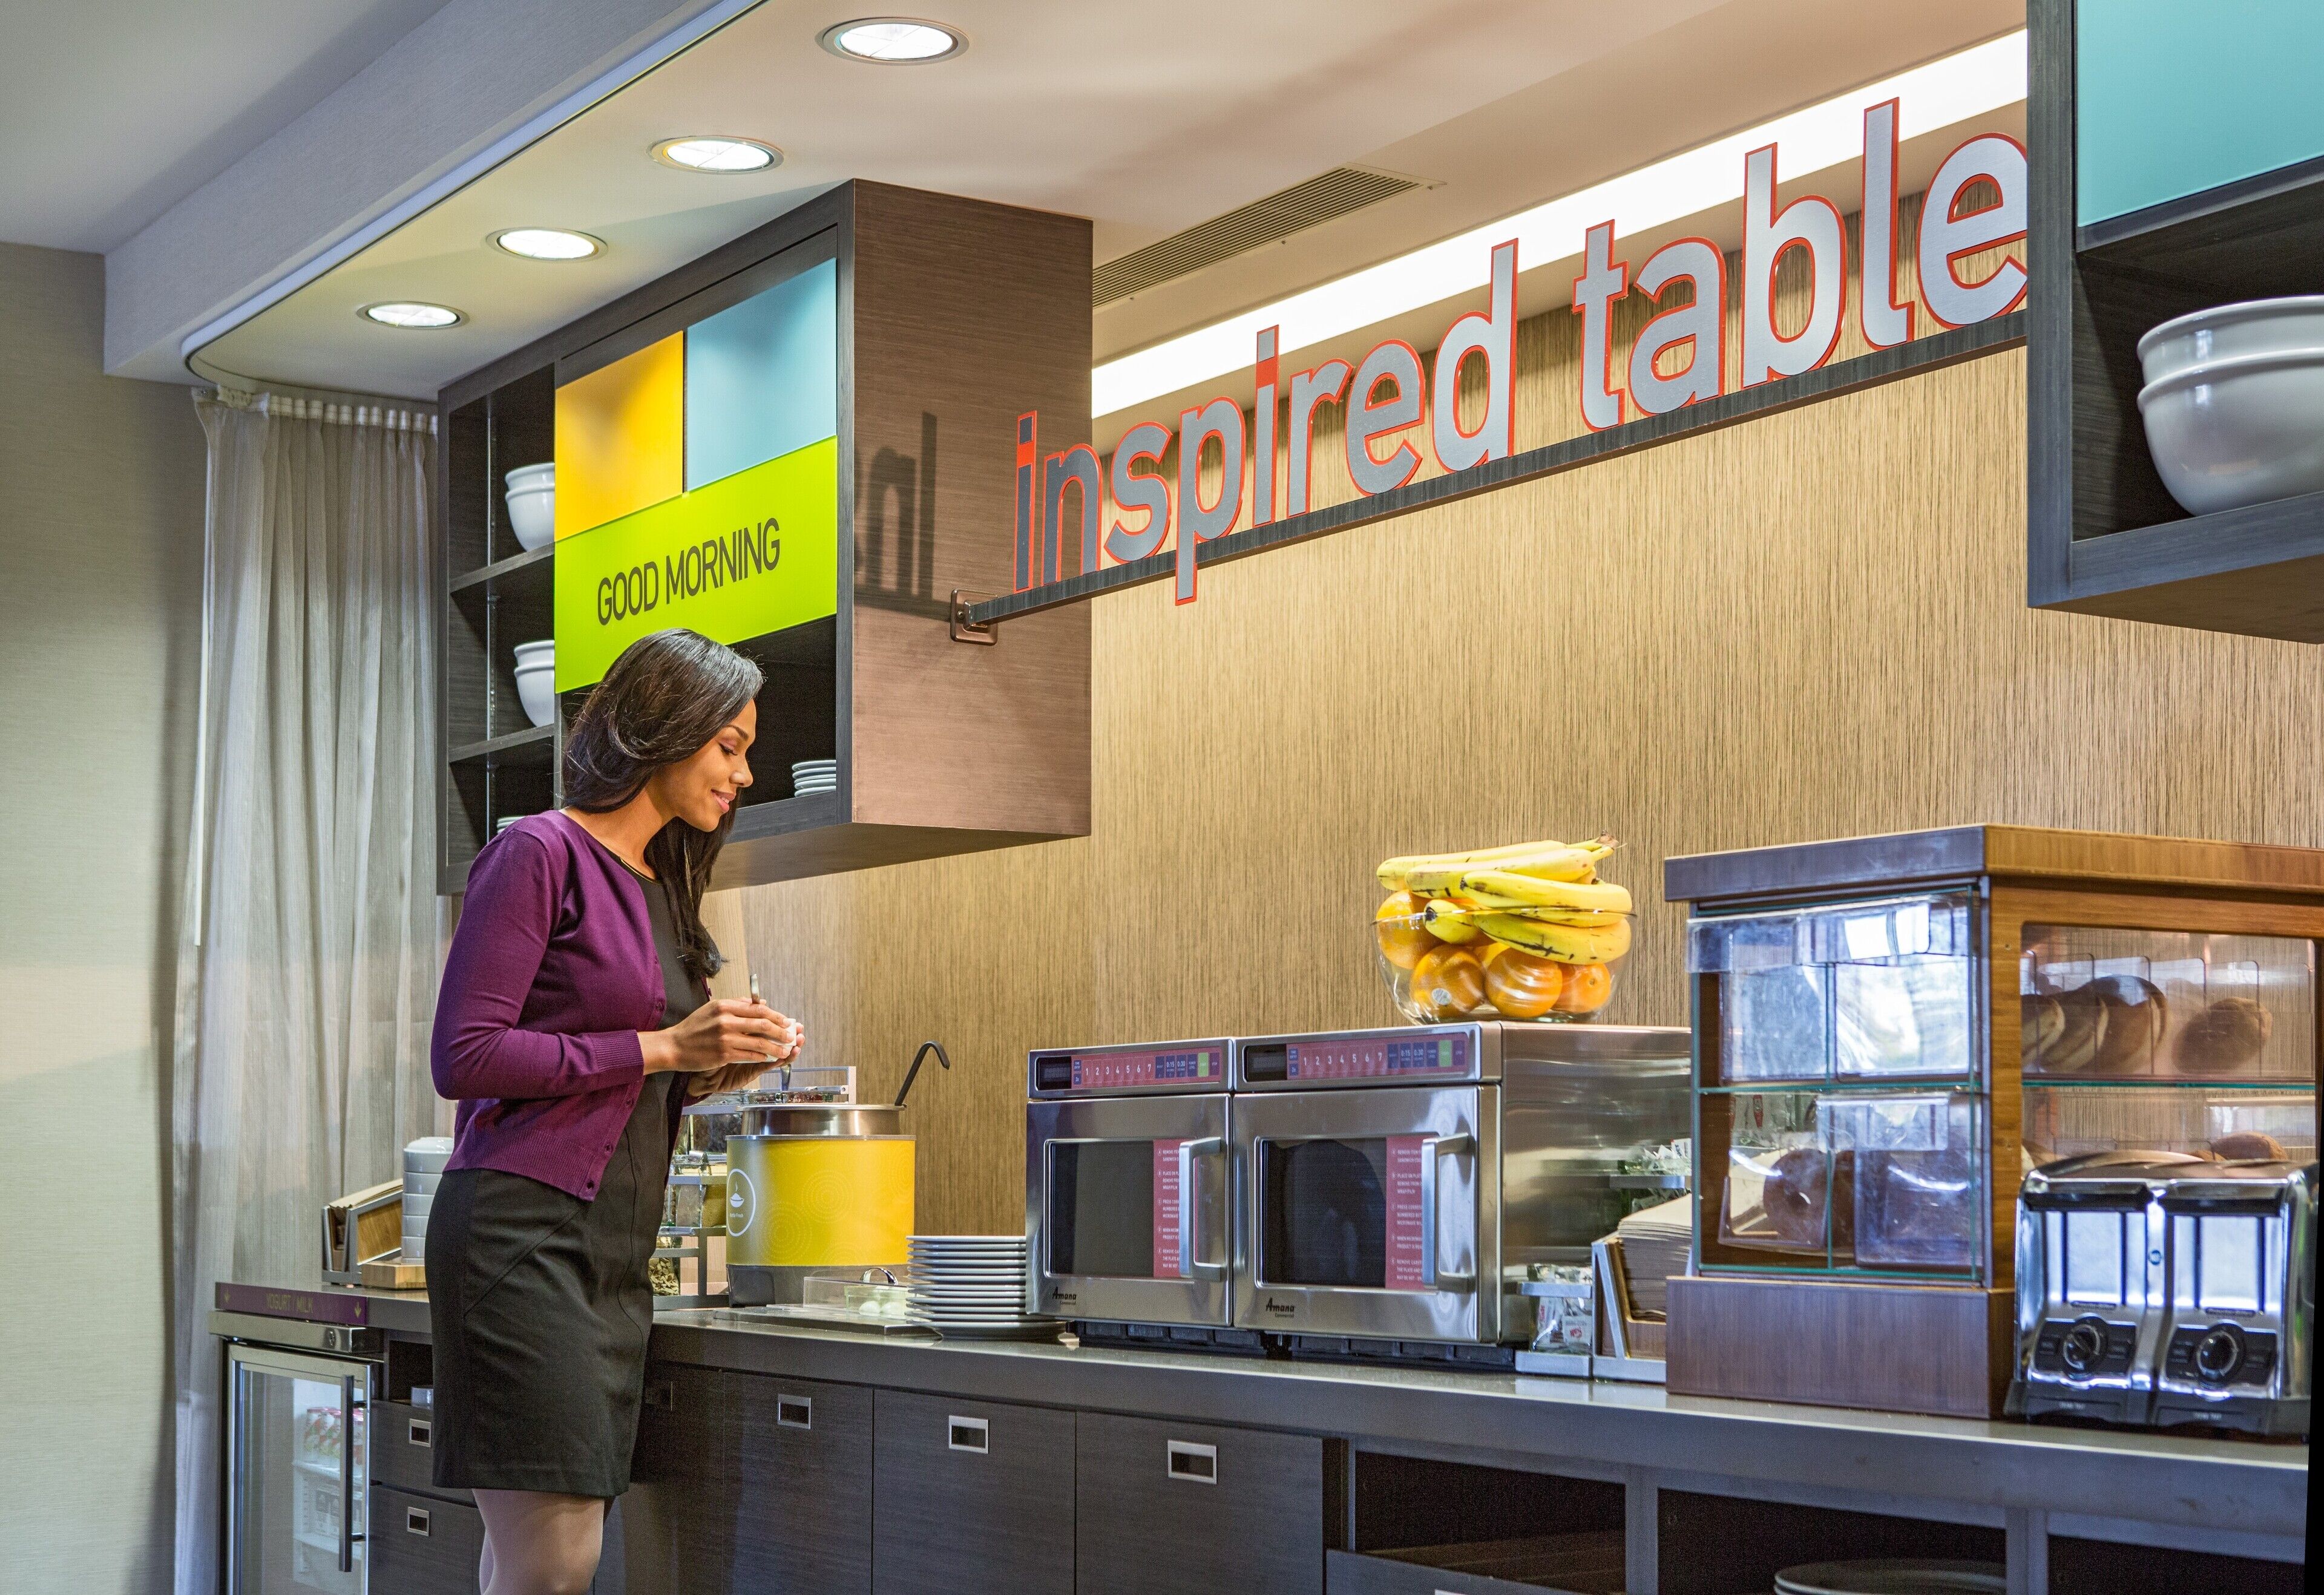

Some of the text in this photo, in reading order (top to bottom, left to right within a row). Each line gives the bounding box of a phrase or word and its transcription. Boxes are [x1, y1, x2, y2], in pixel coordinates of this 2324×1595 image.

[1014, 97, 2027, 605] inspired table
[598, 517, 781, 626] GOOD MORNING
[1304, 1052, 1382, 1066] 1 2 3 4 5 6 7
[1052, 1286, 1077, 1300] Amana
[266, 1293, 291, 1311] YOGURT
[297, 1296, 313, 1313] MILK
[1265, 1297, 1295, 1312] Amana
